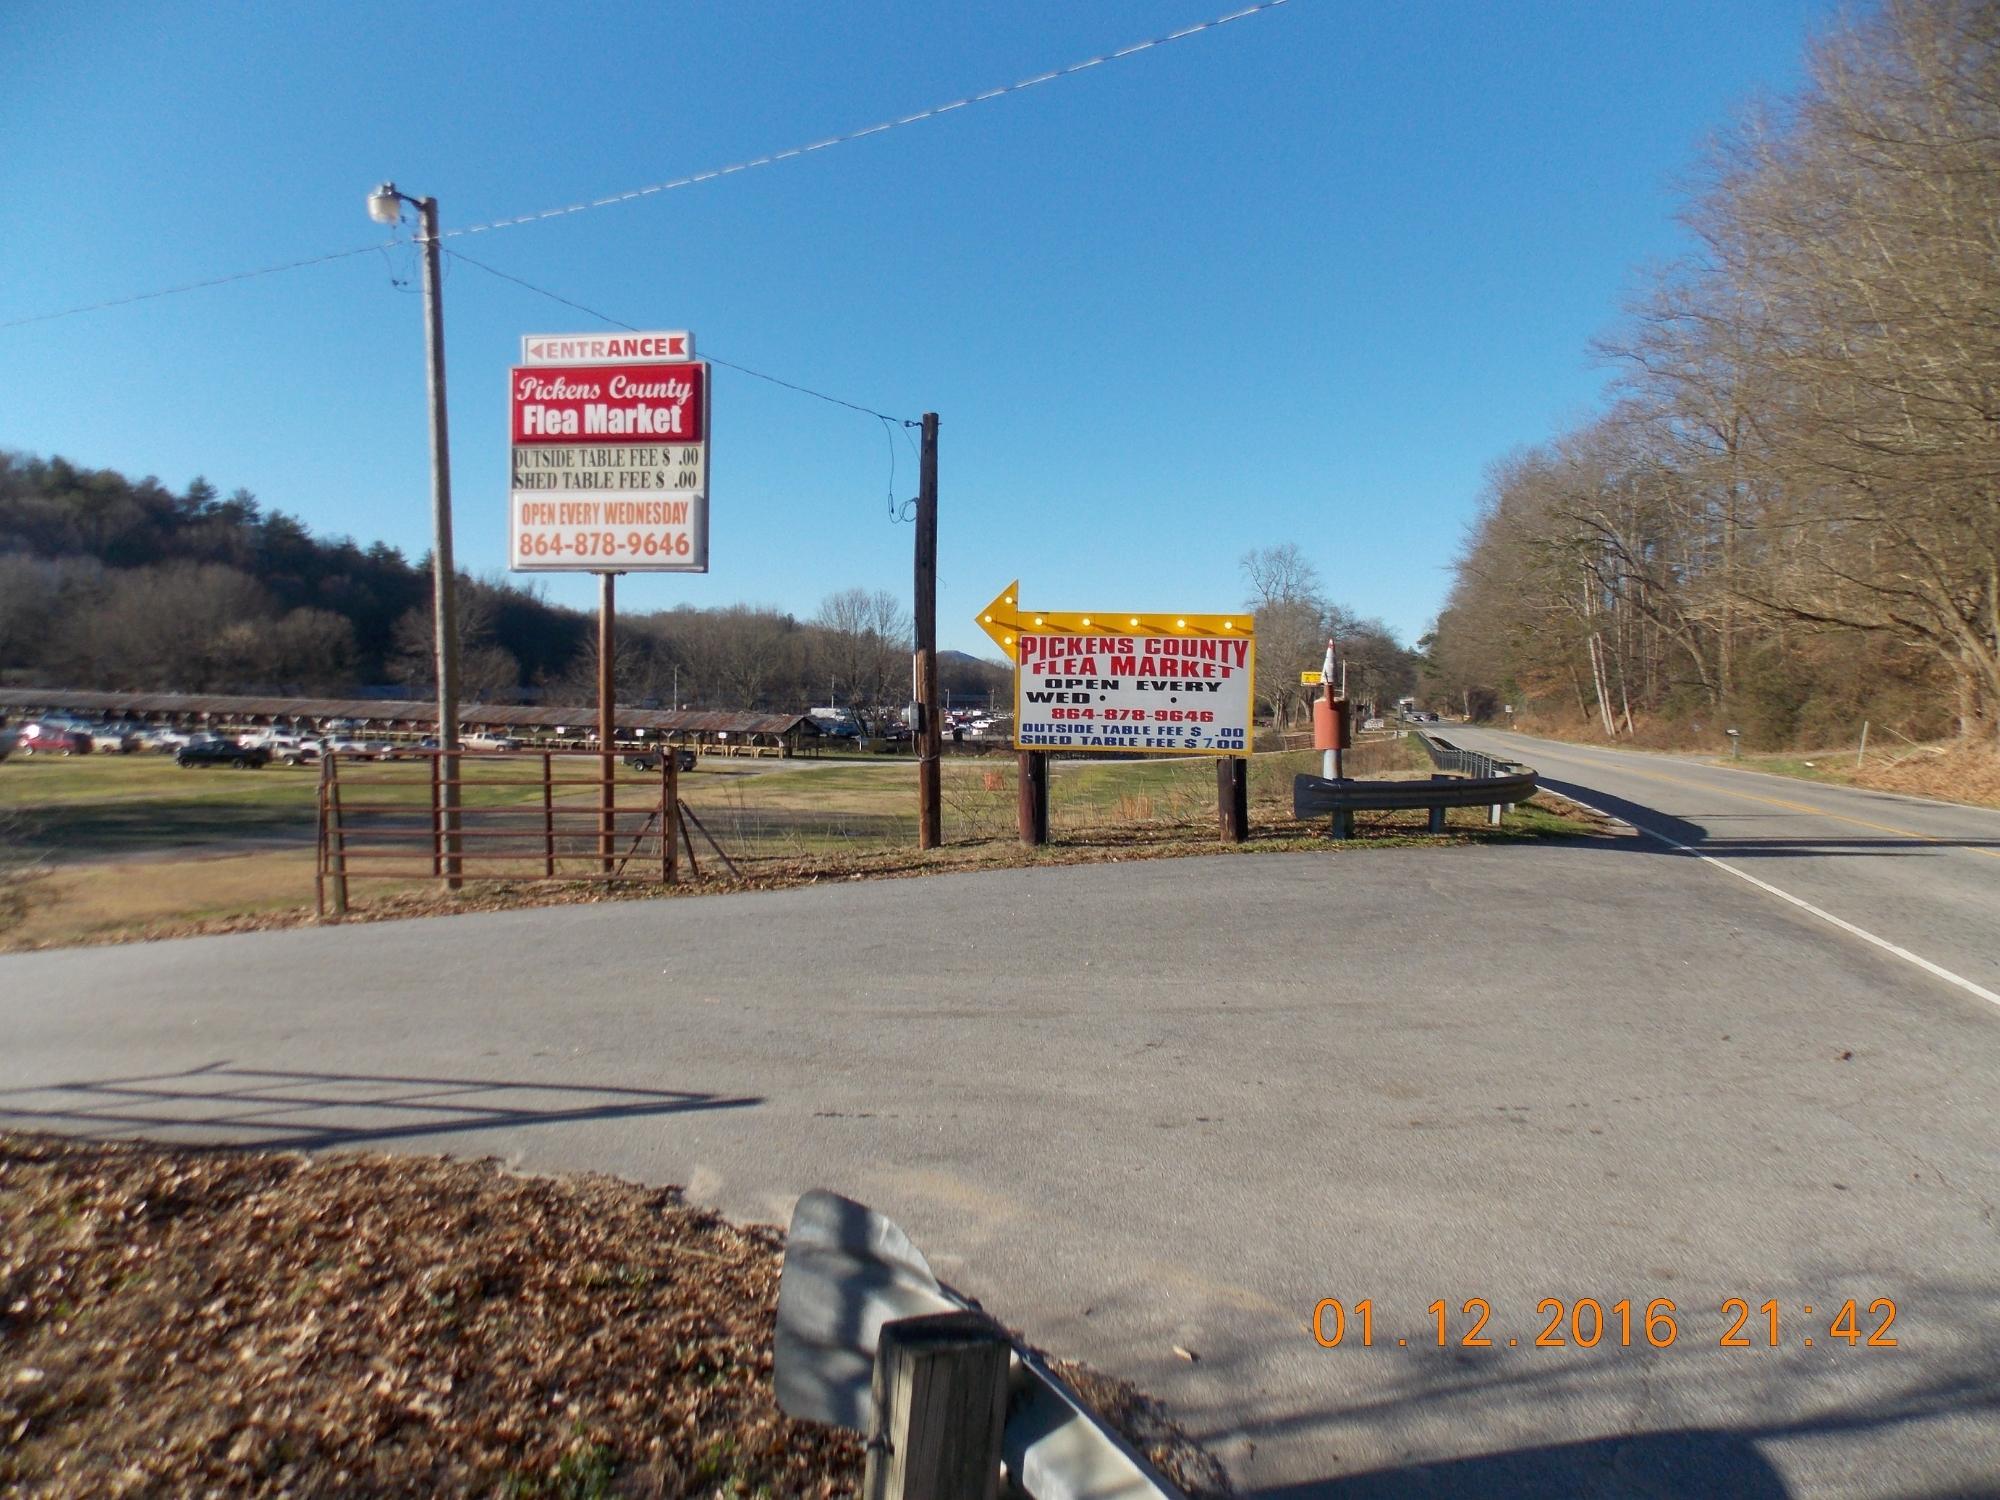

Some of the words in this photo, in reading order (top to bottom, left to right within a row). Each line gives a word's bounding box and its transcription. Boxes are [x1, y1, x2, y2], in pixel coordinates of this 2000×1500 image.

[546, 338, 667, 359] ENTRANCE
[517, 376, 601, 401] Pickens
[608, 375, 693, 405] County
[523, 404, 579, 435] Flea
[584, 403, 683, 434] Market
[579, 449, 626, 467] TABLE
[630, 448, 658, 467] FEE
[514, 472, 558, 489] SHED
[562, 471, 614, 489] TABLE
[619, 471, 651, 489] FEE
[522, 503, 556, 525] OPEN
[559, 503, 601, 525] EVERY
[604, 502, 689, 525] WEDNESDAY
[520, 532, 690, 556] 864-878-9646
[1021, 636, 1135, 666] PICKENS
[1145, 638, 1249, 669] COUNTY
[1032, 656, 1097, 675] FLEA
[1110, 656, 1235, 679] MARKET
[1045, 678, 1120, 691] OPEN
[1136, 680, 1223, 692] EVERY
[1051, 708, 1214, 722] 864-878-9646
[1022, 723, 1094, 735] OUTSIDE
[1101, 724, 1151, 736] TABLE
[1157, 726, 1184, 737] FEE
[1020, 734, 1072, 745] SHED
[1081, 735, 1138, 747] TABLE
[1147, 737, 1176, 748] FEE
